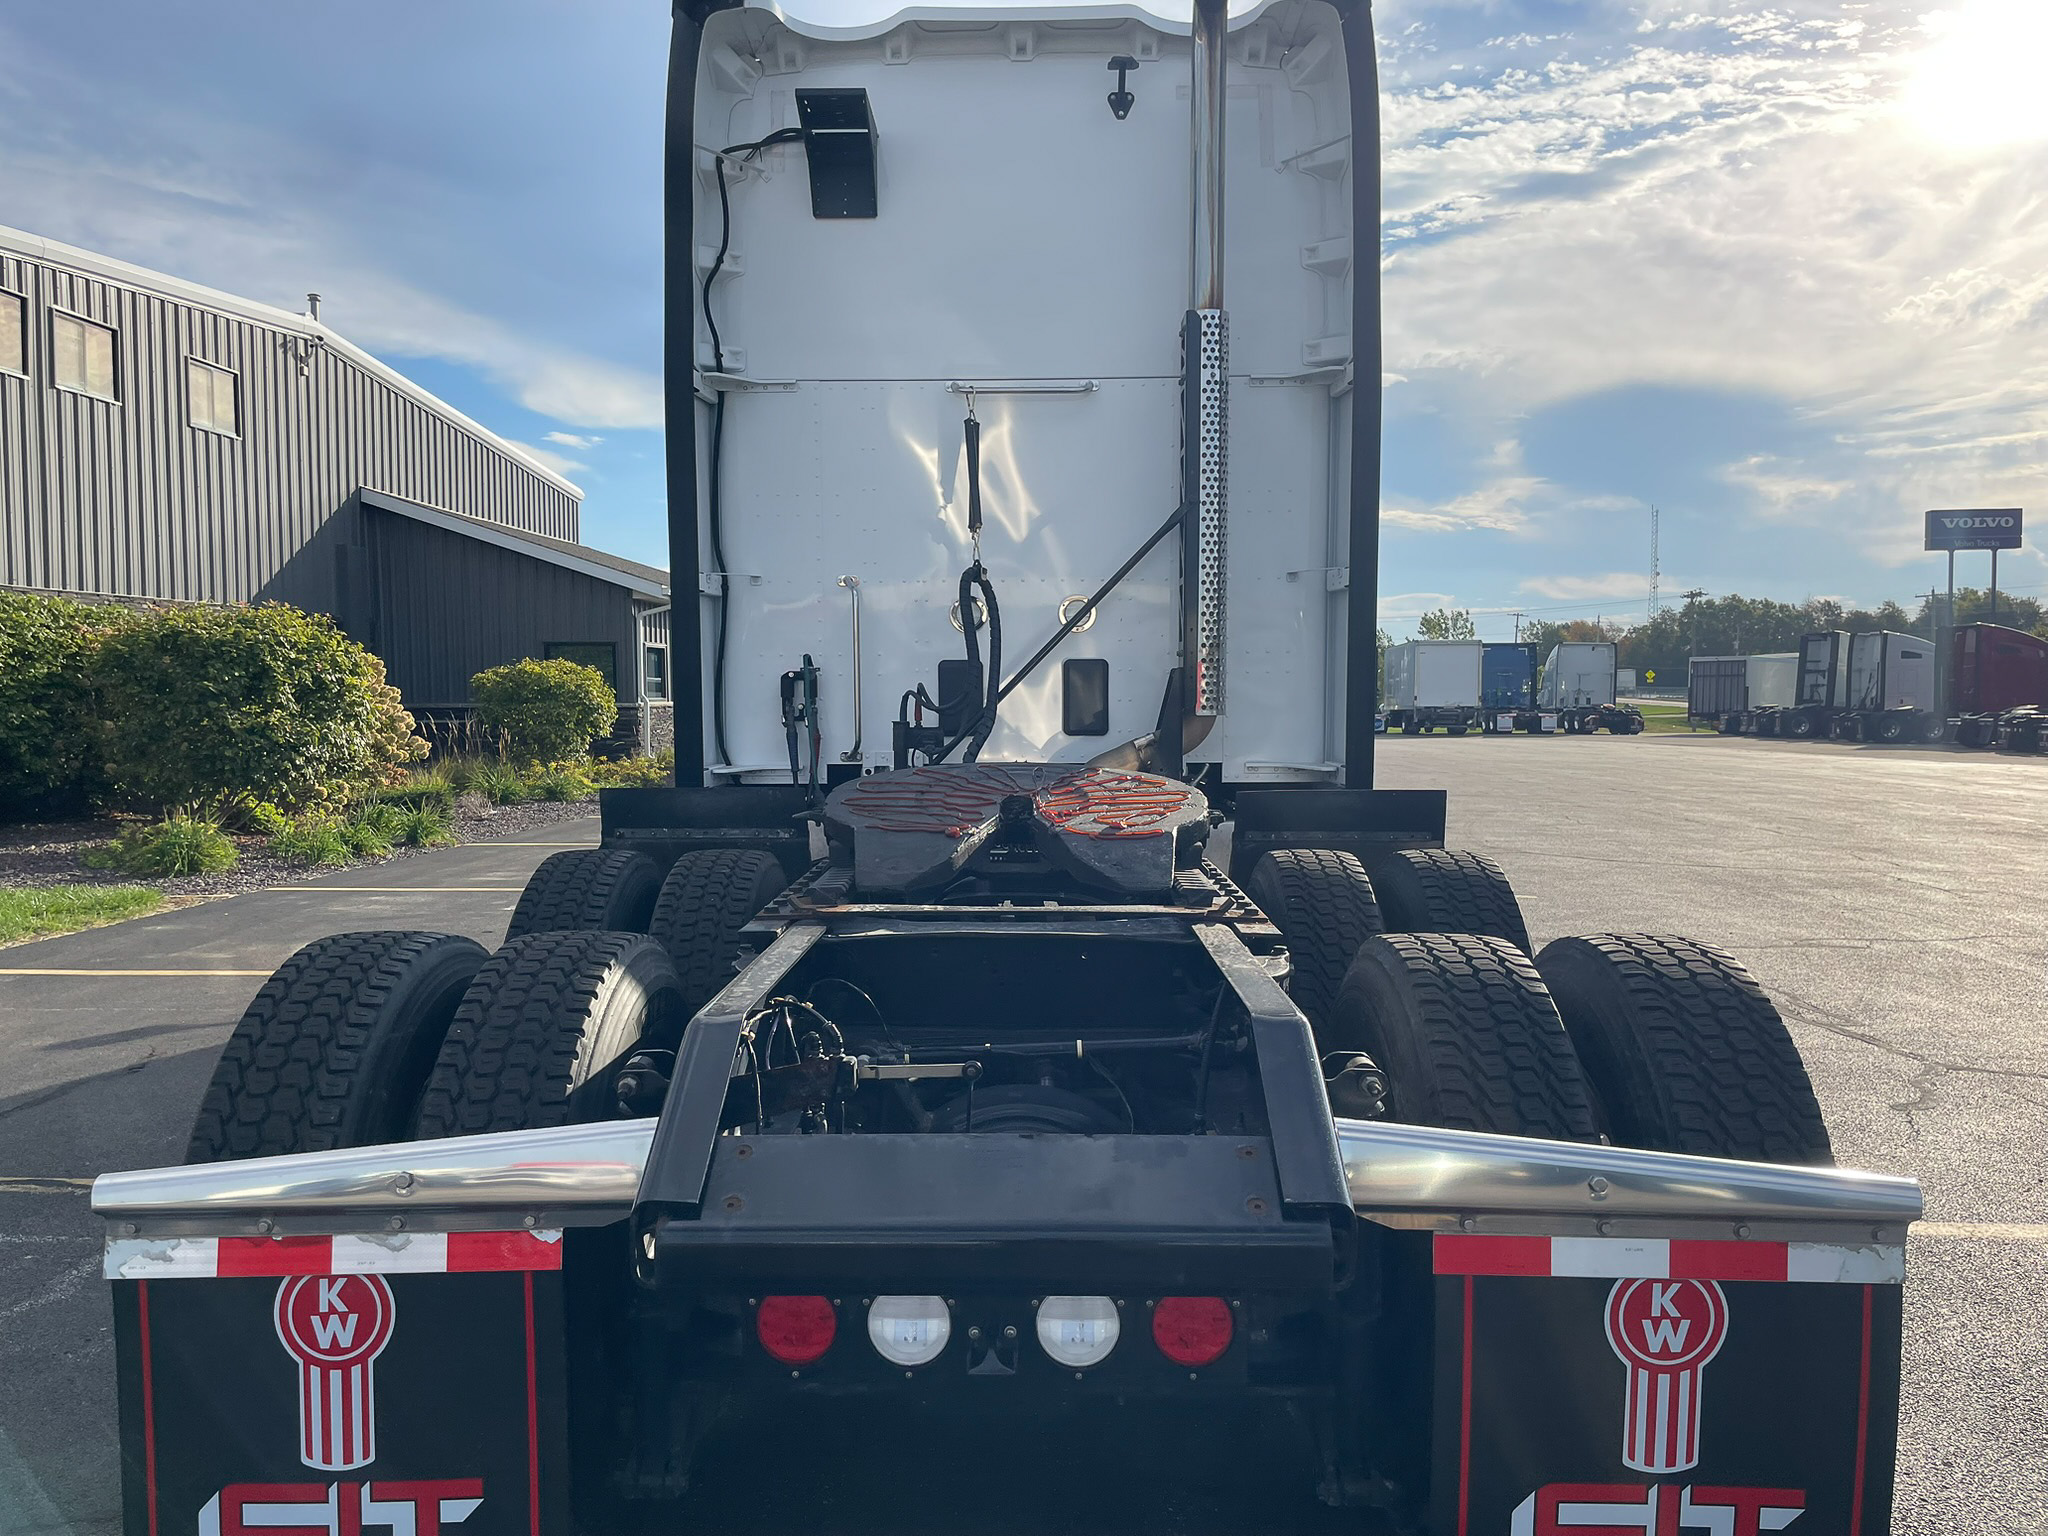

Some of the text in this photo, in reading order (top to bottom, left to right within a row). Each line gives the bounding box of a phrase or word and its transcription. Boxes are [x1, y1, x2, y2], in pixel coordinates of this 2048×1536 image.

[1941, 517, 2014, 528] VOLVO
[1977, 539, 2000, 547] Trucks
[319, 1277, 349, 1313] K
[1651, 1282, 1682, 1317] K
[310, 1313, 359, 1350] W
[1641, 1319, 1691, 1353] W
